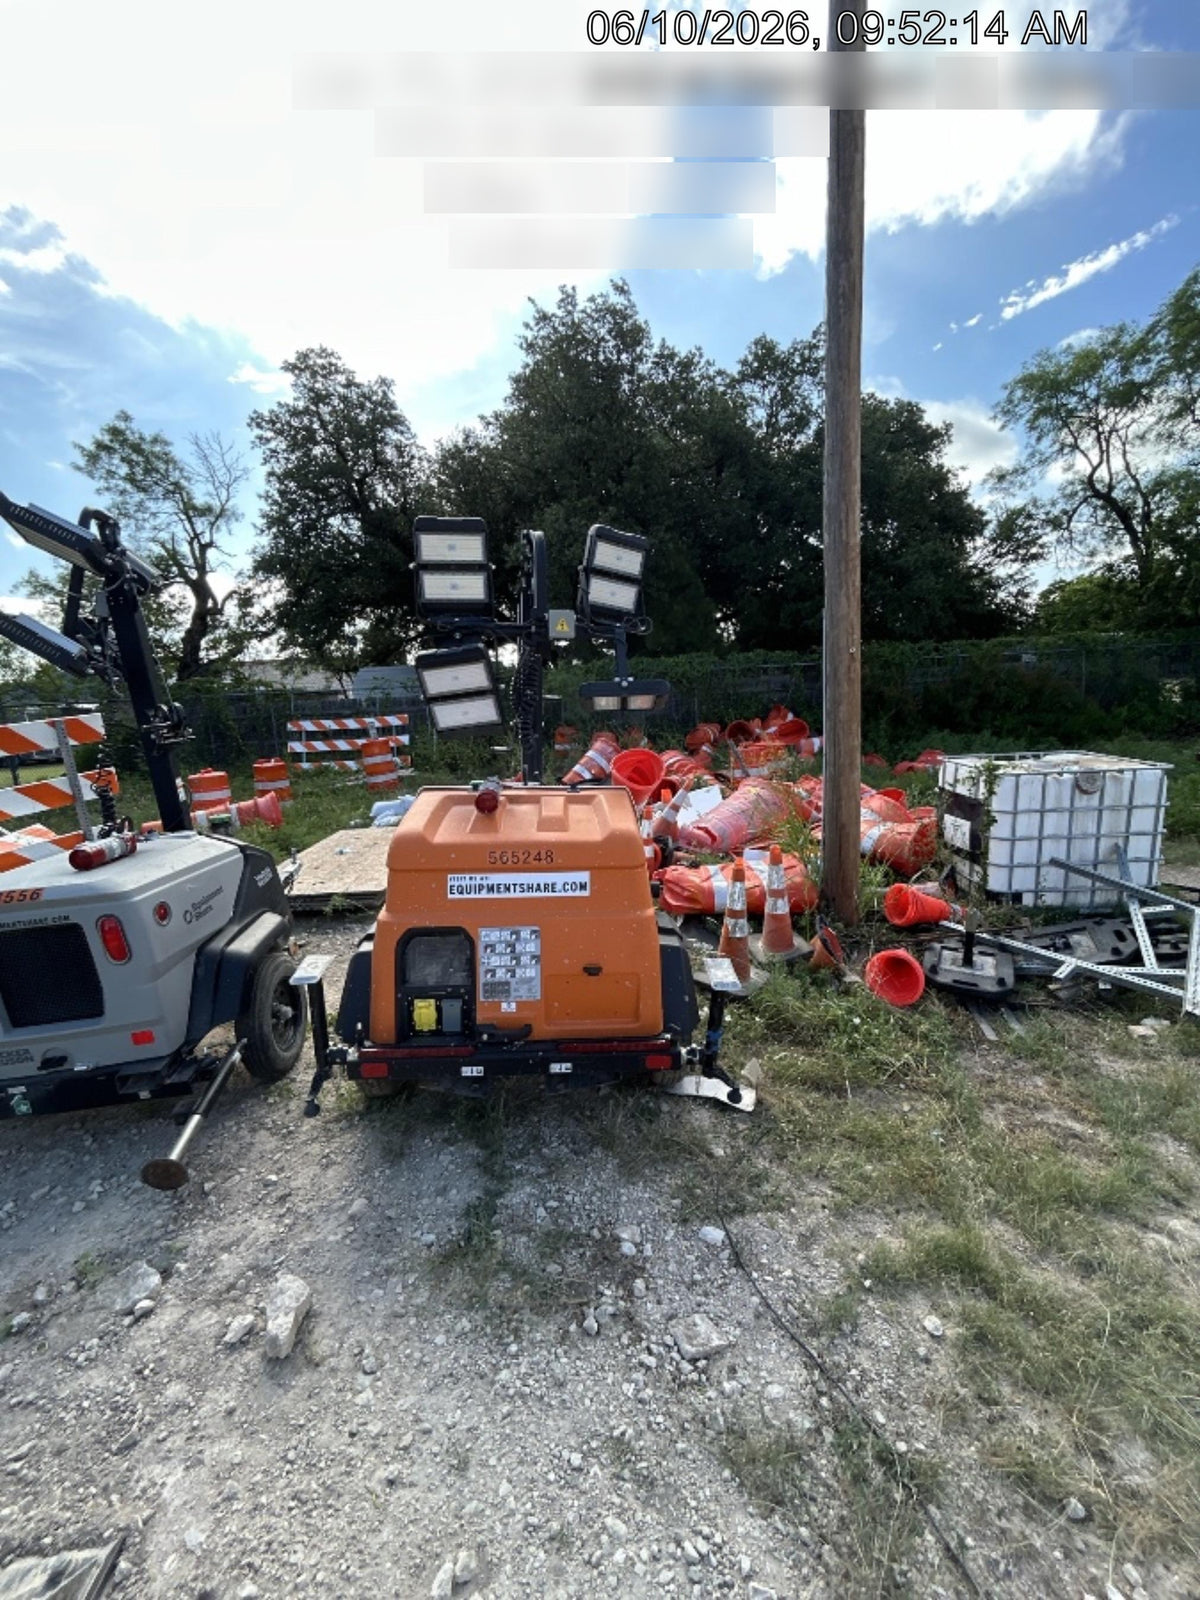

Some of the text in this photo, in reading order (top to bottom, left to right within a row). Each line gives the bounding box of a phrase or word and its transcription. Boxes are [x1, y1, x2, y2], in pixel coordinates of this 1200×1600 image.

[488, 850, 554, 865] 565248
[449, 881, 588, 895] EQUIPMENTSHARE.COM
[0, 888, 42, 904] 556
